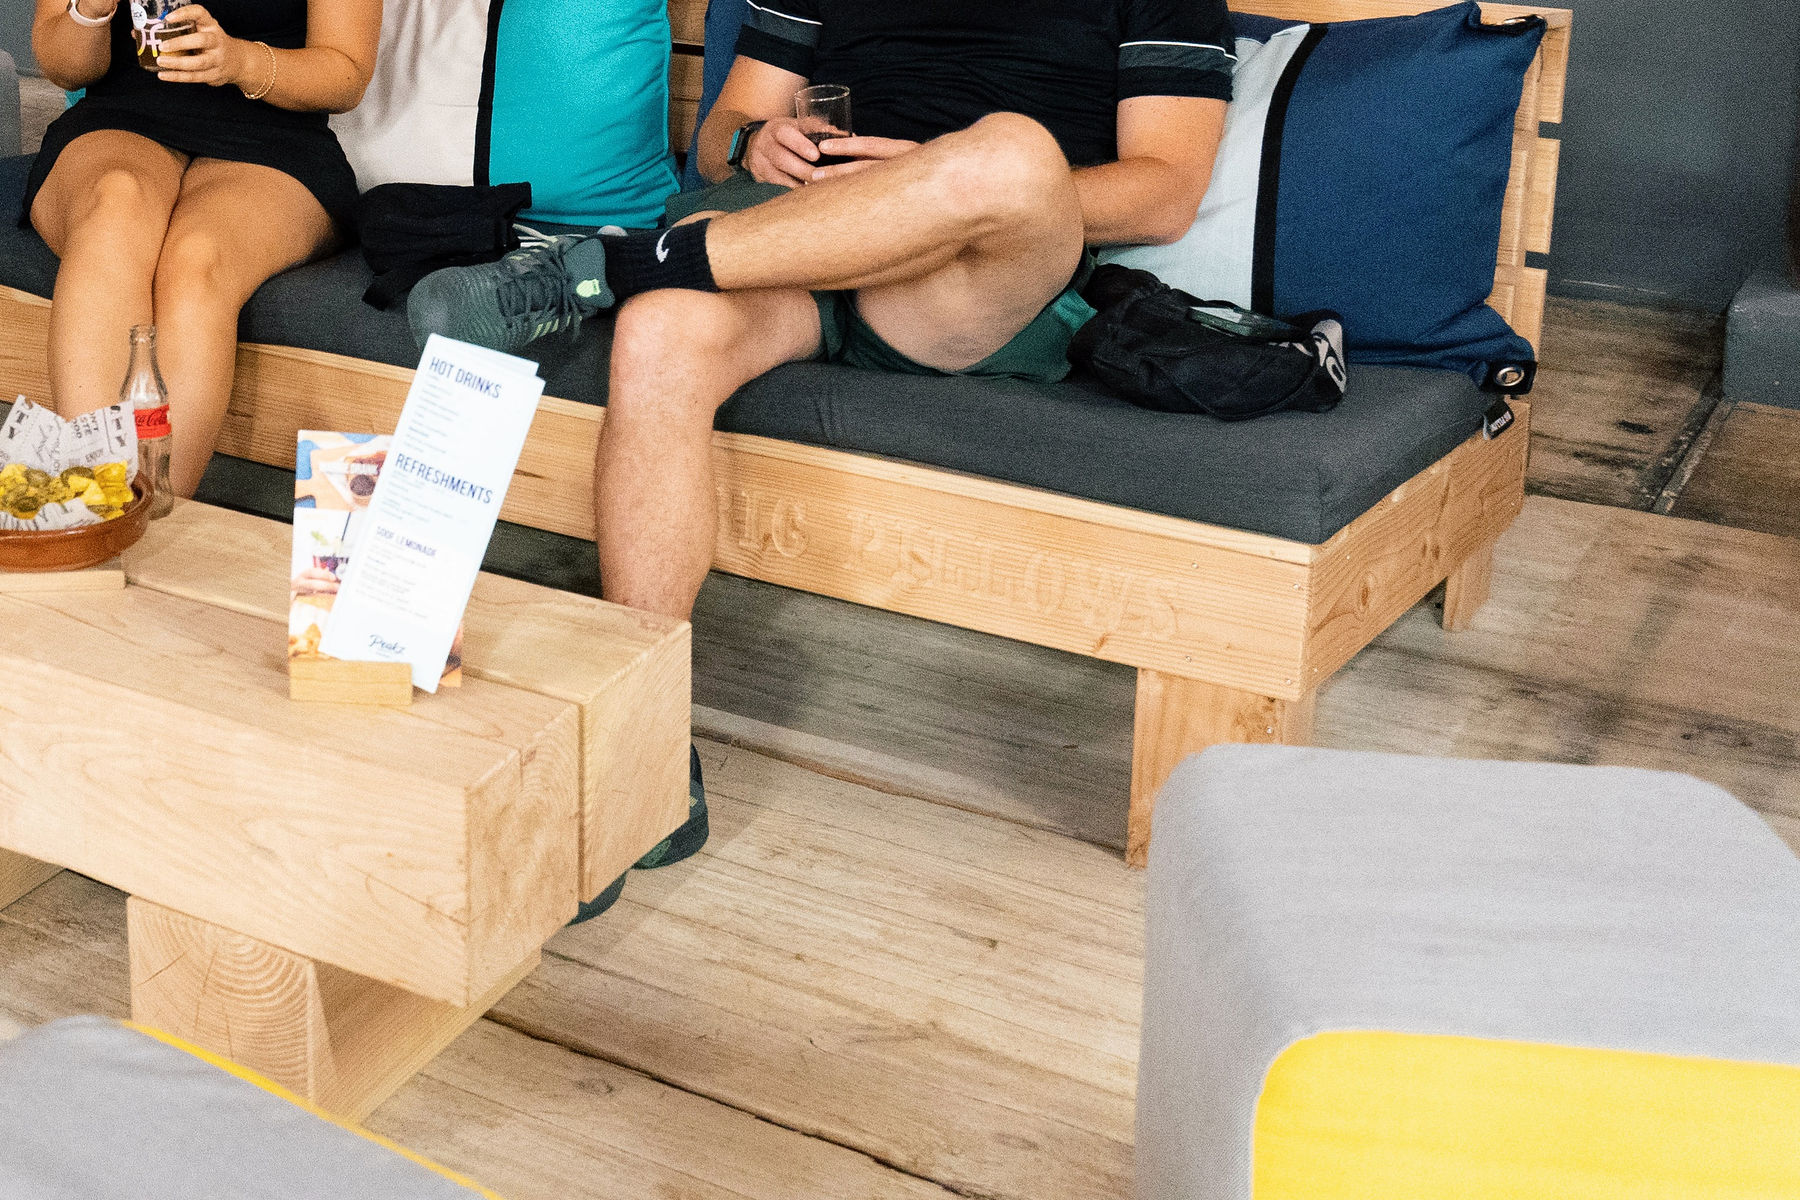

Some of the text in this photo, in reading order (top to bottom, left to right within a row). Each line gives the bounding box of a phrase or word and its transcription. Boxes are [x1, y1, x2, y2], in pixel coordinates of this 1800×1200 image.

[429, 356, 502, 399] HOT DRINKS
[395, 452, 494, 505] REFRESHMENTS
